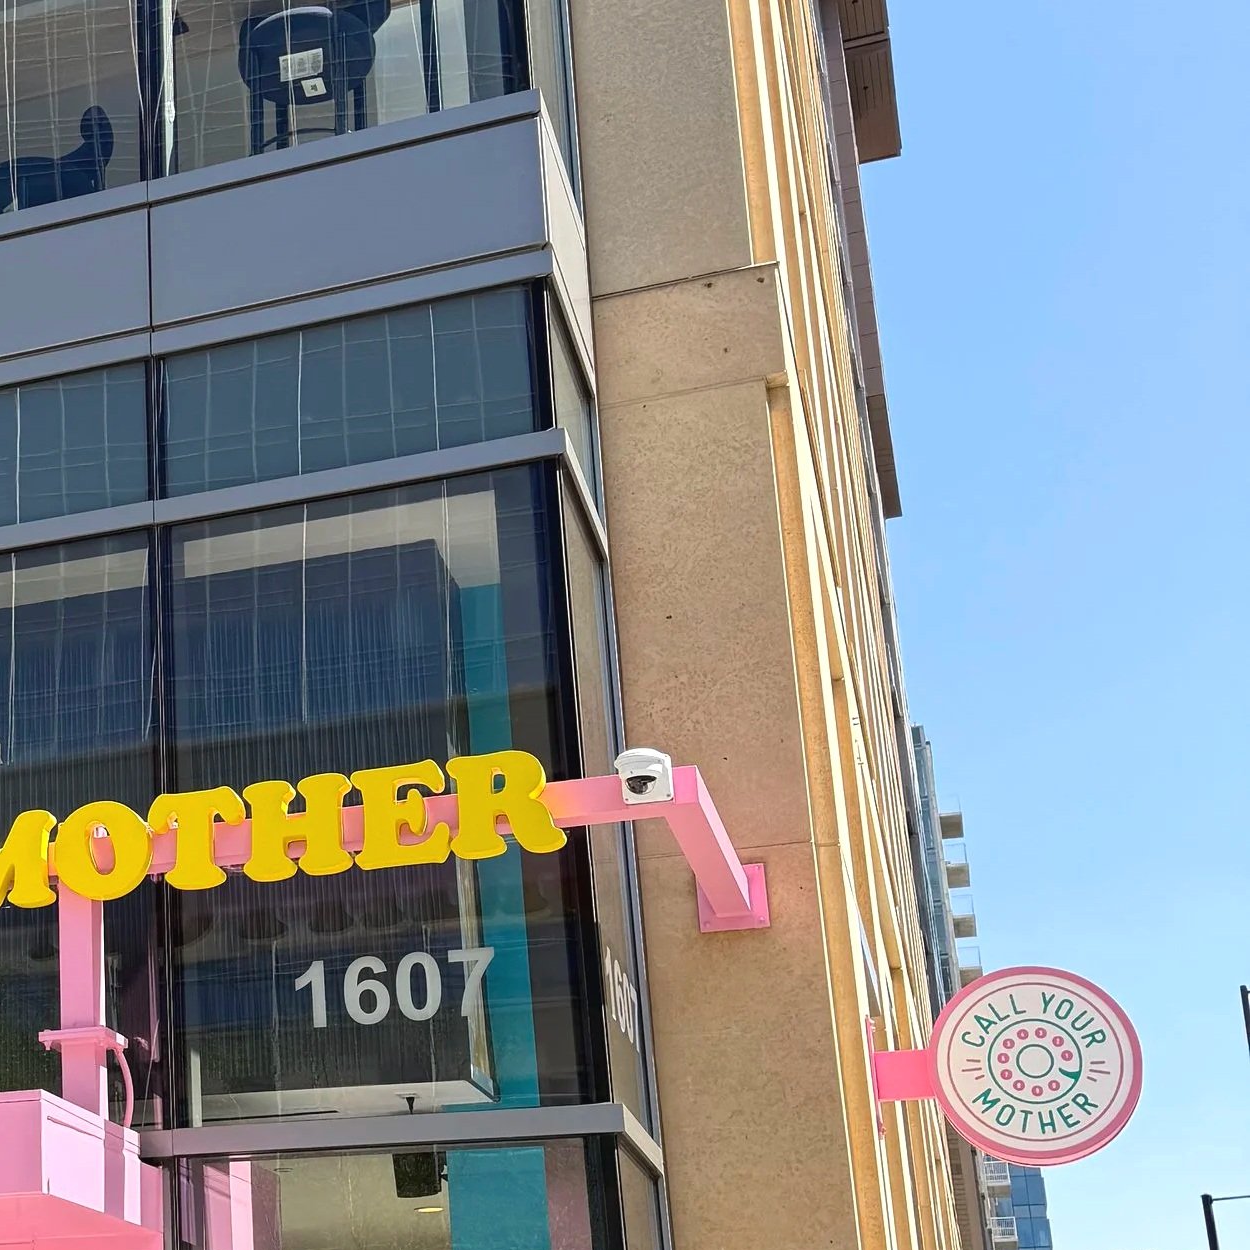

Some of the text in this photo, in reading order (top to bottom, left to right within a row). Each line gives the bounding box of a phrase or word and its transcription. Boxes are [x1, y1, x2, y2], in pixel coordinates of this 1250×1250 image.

[294, 946, 495, 1028] 1607
[605, 946, 640, 1053] 1607
[961, 991, 1107, 1048] CALL YOUR
[971, 1087, 1099, 1134] MOTHER
